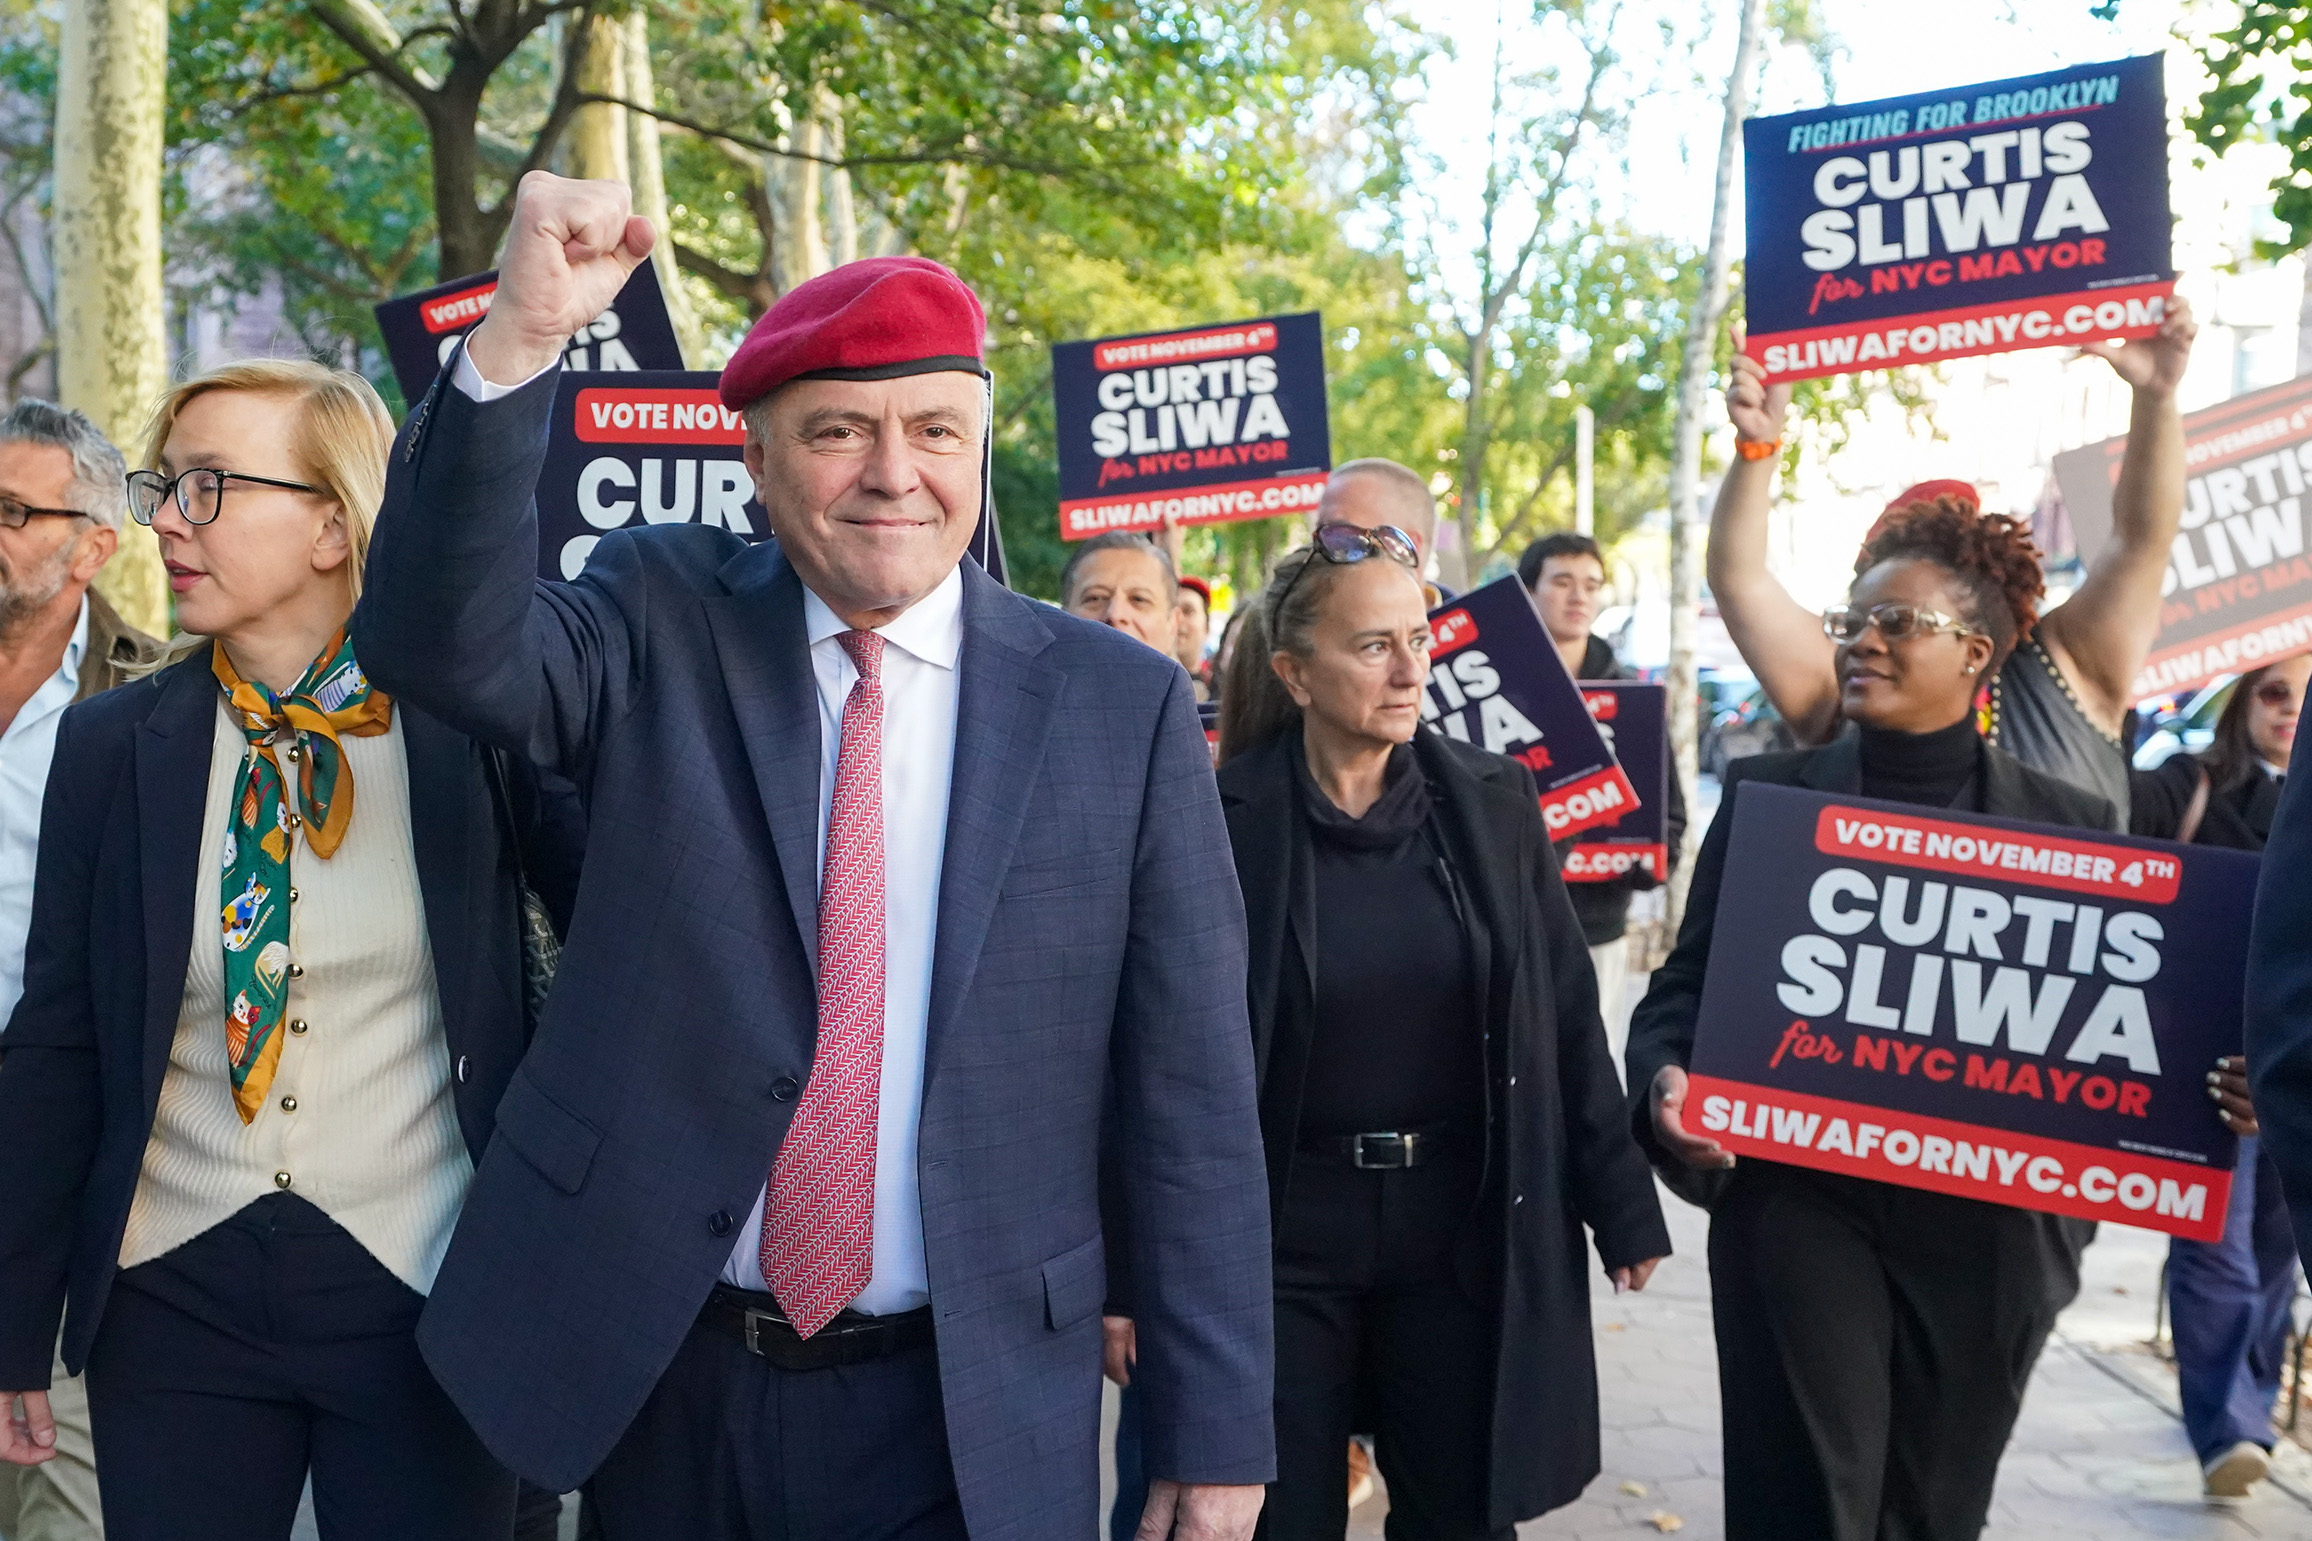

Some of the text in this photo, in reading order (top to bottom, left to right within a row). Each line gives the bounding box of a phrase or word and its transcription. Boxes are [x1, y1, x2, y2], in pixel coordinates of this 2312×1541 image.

[1788, 75, 2119, 152] FIGHTING FOR BROOKLYN
[1813, 121, 2093, 208] CURTIS
[1800, 173, 2110, 272] SLIWA
[429, 298, 477, 325] VOTE
[1808, 239, 2107, 315] for NYC MAYOR
[1102, 344, 1148, 363] VOTE
[1150, 333, 1243, 358] NOVEMBER
[1764, 296, 2166, 372] SLIWAFORNYC.COM
[591, 402, 747, 430] VOTE NOV
[1097, 355, 1278, 411] CURTIS
[1091, 393, 1291, 458] SLIWA
[576, 456, 755, 534] CUR
[1098, 440, 1288, 488] for NYC MAYOR
[1070, 482, 1326, 530] SLIWAFORNYC.COM
[2194, 573, 2260, 615] NYC
[2261, 552, 2312, 592] MA
[1544, 780, 1625, 829] COM
[1834, 818, 2174, 887] VOTE NOVEMBER 4TH
[1808, 867, 2165, 983] CURTIS
[1776, 934, 2161, 1076] SLIWA
[1769, 1019, 2152, 1117] for NYC MAYOR
[1701, 1094, 2207, 1222] SLIWAFORNYC.COM
